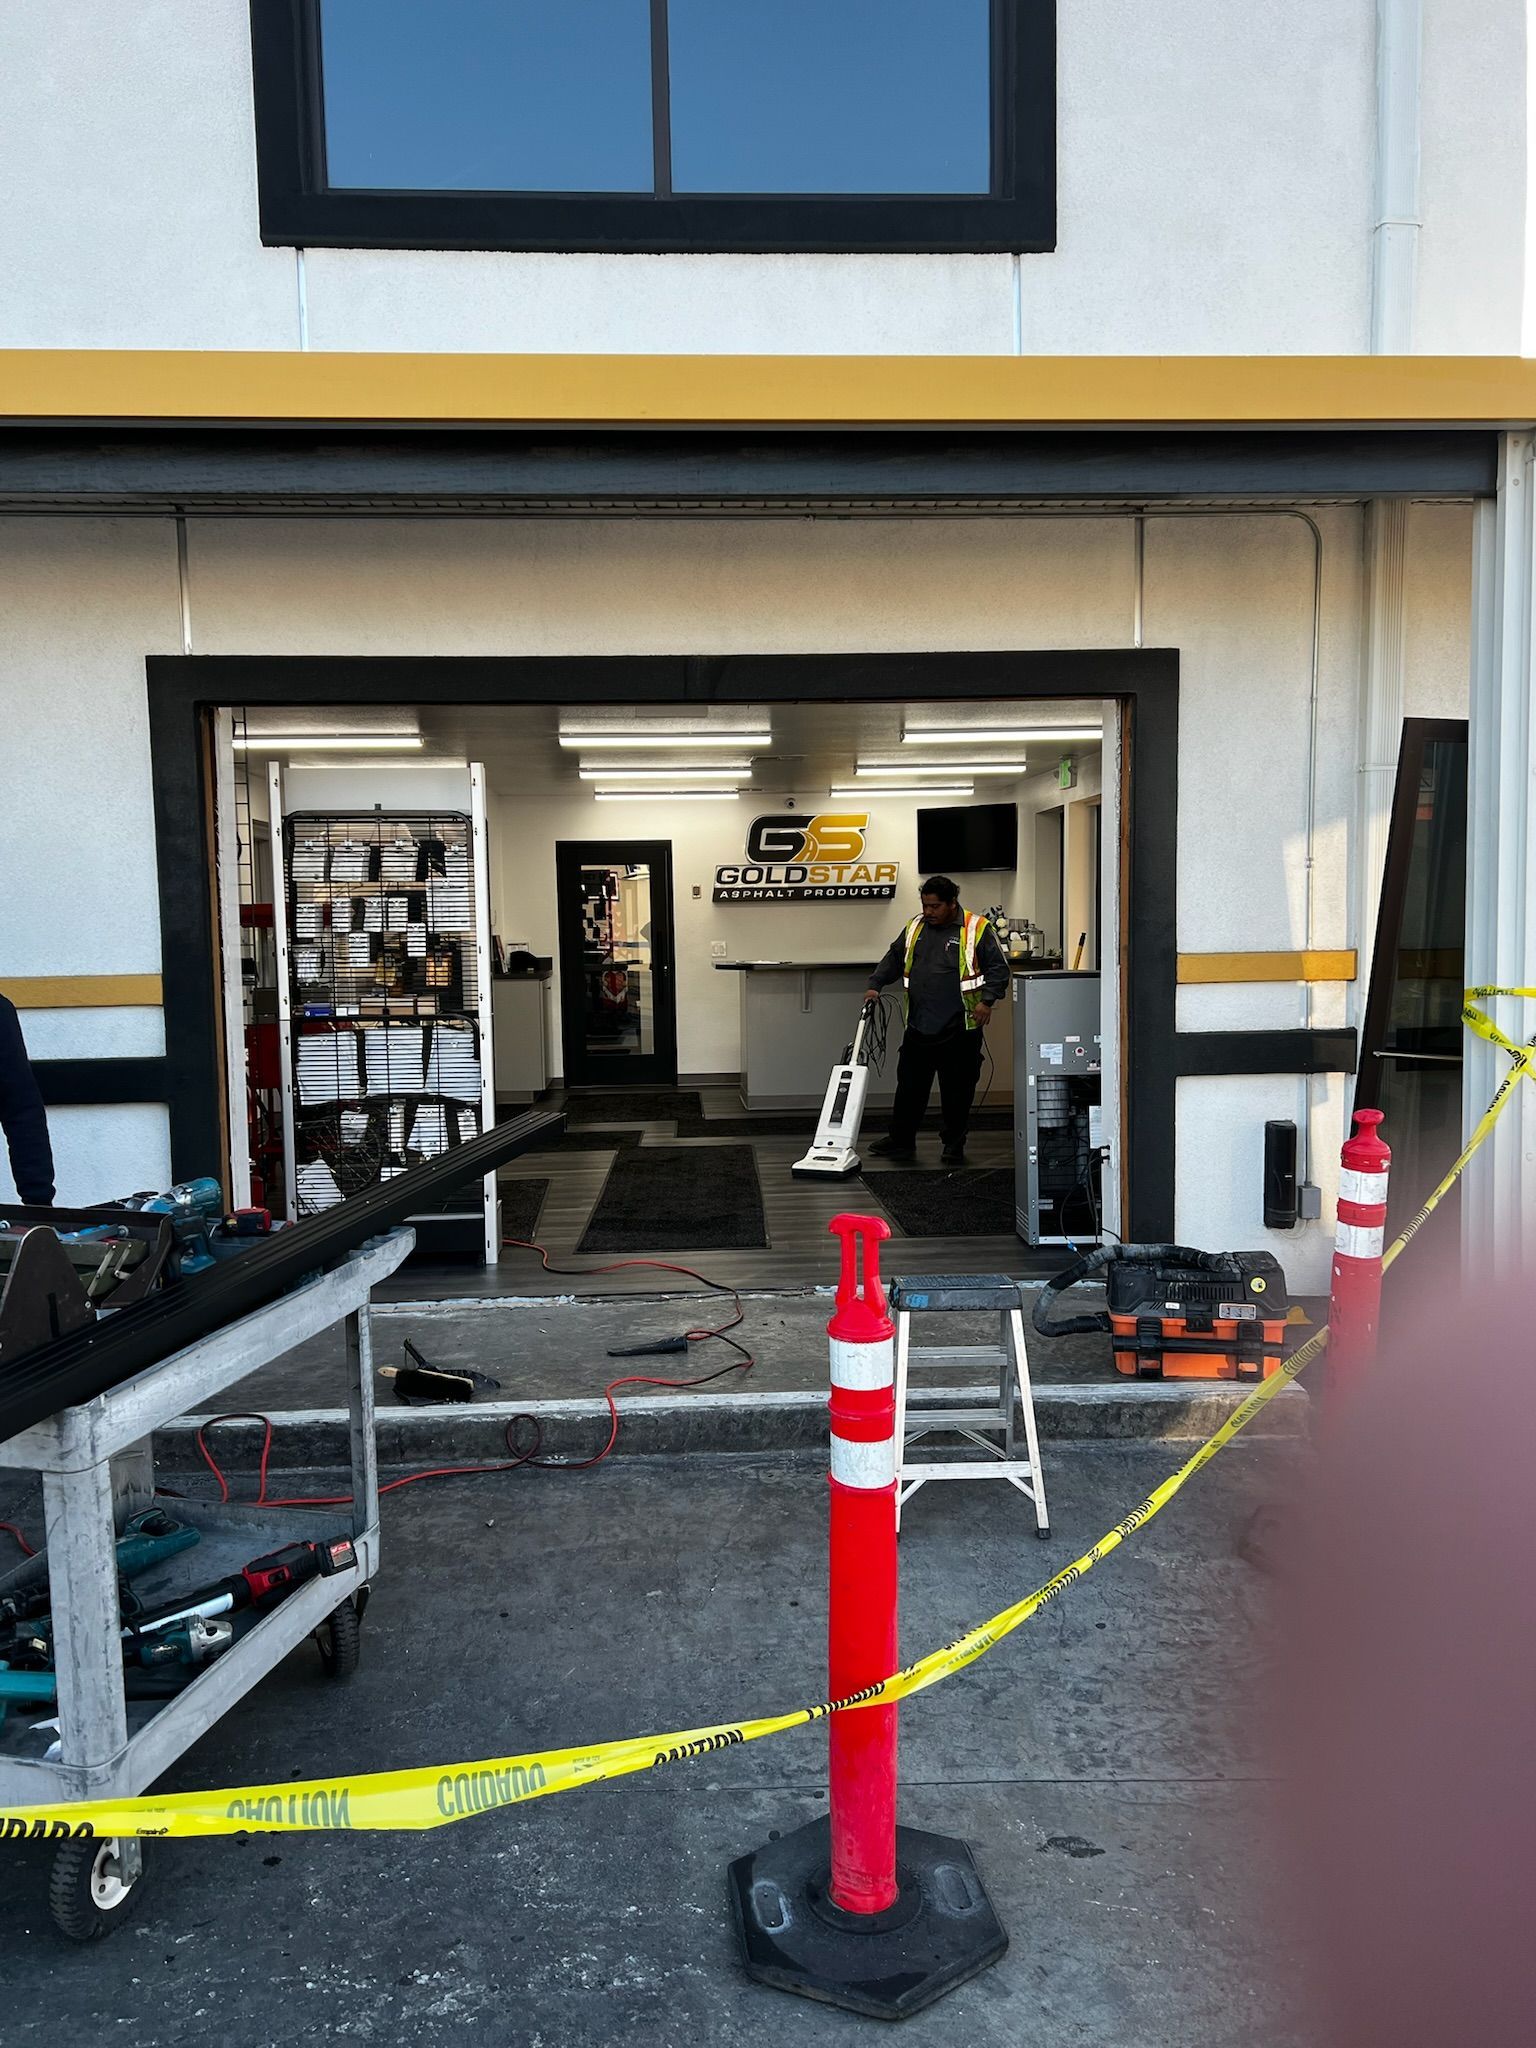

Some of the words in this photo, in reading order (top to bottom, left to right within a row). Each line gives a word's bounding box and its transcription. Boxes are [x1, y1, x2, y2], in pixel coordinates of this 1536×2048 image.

[748, 813, 870, 863] GS
[716, 865, 896, 885] GOLDSTAR
[720, 889, 795, 899] ASPHALT
[803, 887, 891, 897] PRODUCTS
[653, 1729, 744, 1766] CAUTION
